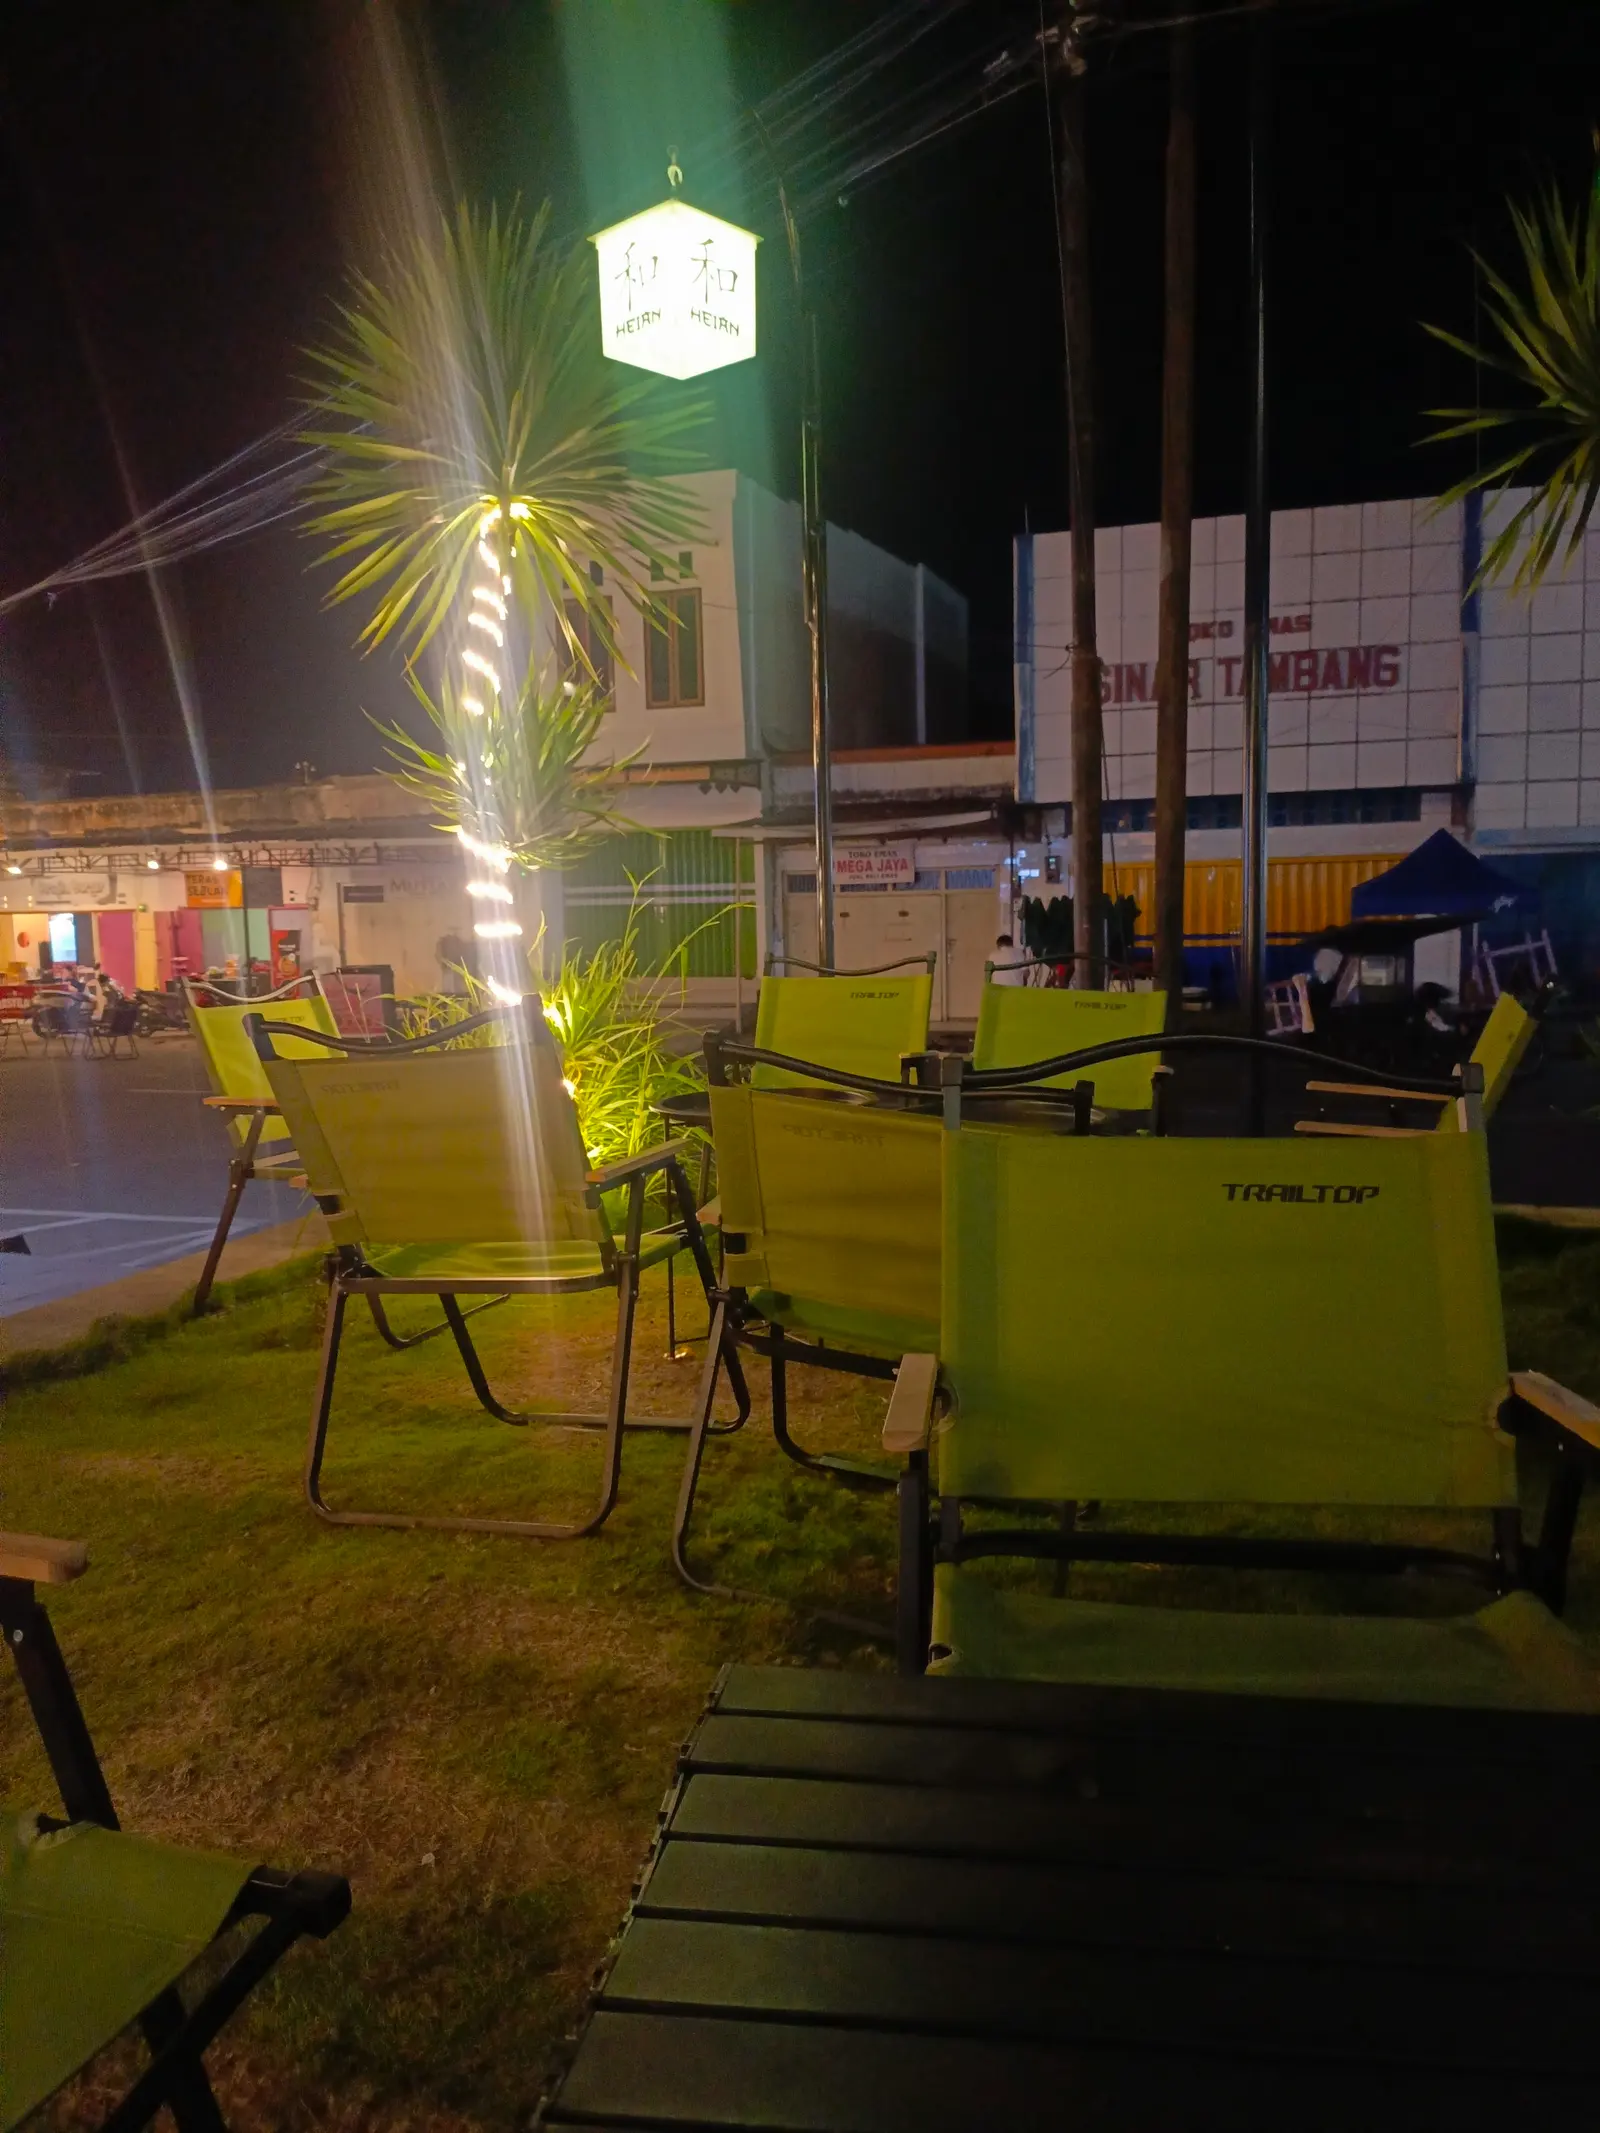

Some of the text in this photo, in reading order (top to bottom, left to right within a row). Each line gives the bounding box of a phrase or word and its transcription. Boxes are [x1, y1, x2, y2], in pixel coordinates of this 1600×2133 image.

[690, 238, 738, 304] 和
[616, 308, 661, 337] HEIAN
[691, 306, 739, 336] HEIAN
[1189, 614, 1312, 641] OKO MAS
[1100, 658, 1201, 703] SINR
[836, 858, 908, 873] MEGA JAYA
[1221, 1183, 1380, 1204] TRAILTOP
